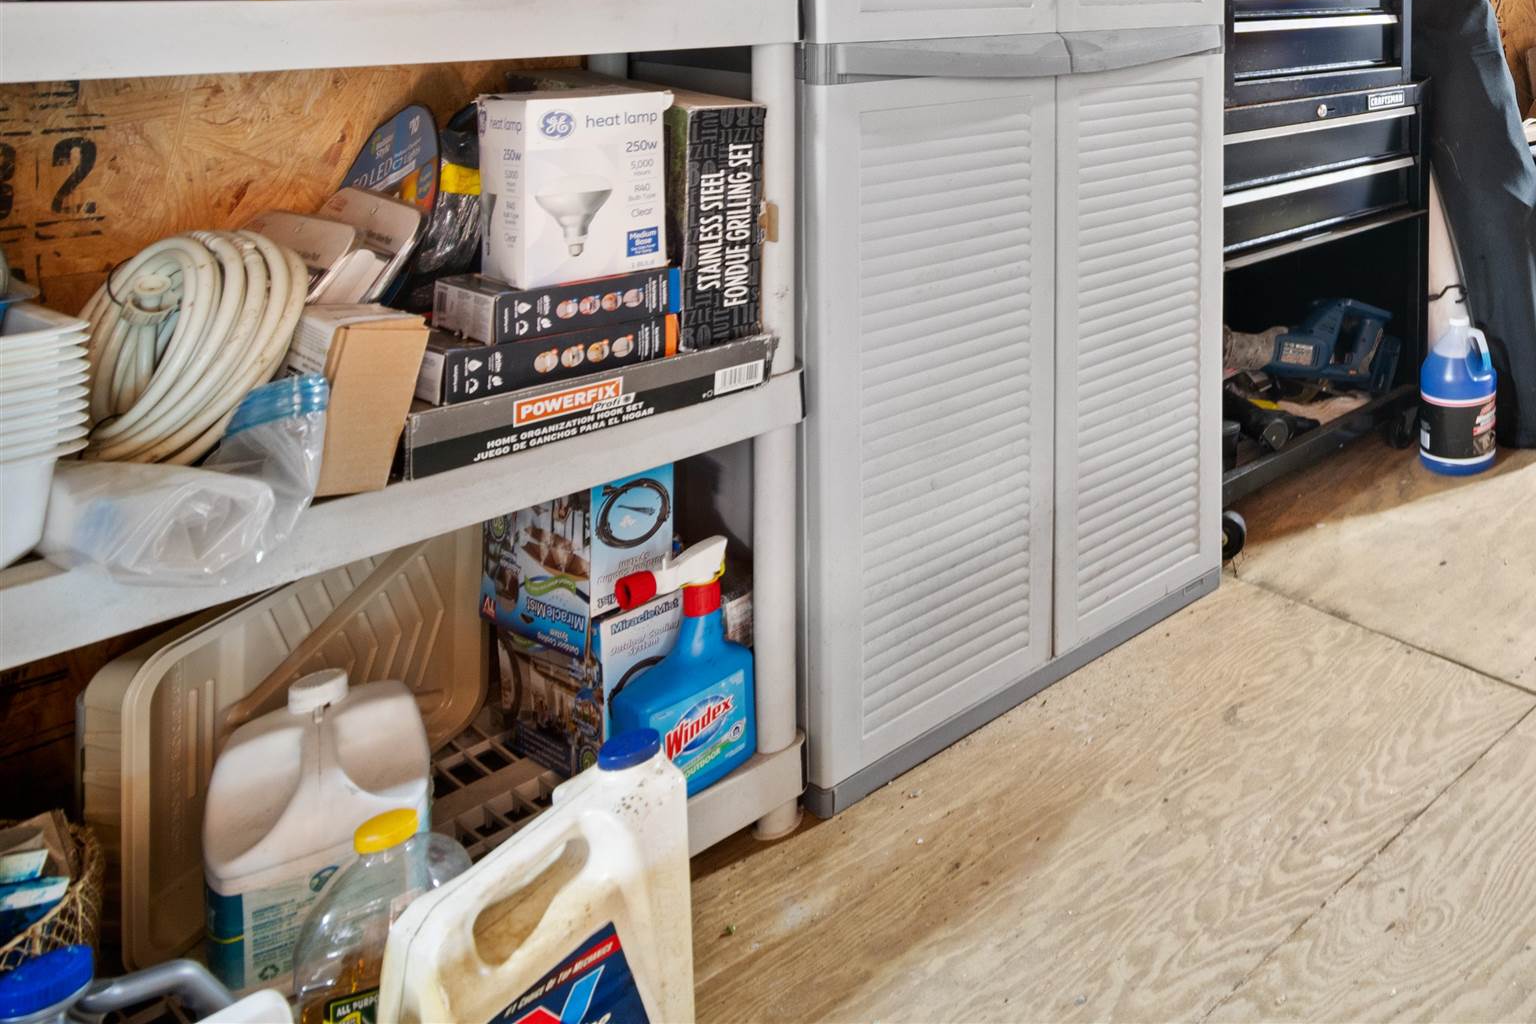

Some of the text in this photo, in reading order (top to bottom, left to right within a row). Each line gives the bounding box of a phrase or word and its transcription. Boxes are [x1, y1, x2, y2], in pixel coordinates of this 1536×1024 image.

[1369, 92, 1404, 108] CRAFTSMAN
[503, 118, 523, 135] lamp
[585, 110, 658, 129] heat lamp
[503, 147, 522, 163] 250w
[625, 139, 658, 154] 250w
[630, 158, 654, 171] 5,000
[633, 182, 651, 194] R40
[630, 206, 654, 219] Clear
[697, 169, 725, 291] STAINLESS STEEL
[724, 142, 753, 308] FONDUE GRILLING SET
[629, 228, 658, 242] Medium
[519, 380, 620, 420] POWERFIX
[593, 397, 622, 413] Profi
[486, 400, 645, 450] HOME ORGANIZATION HOOK SET
[473, 406, 656, 463] JUEGO DE GANCHOS PARA EL HOGAR
[526, 597, 586, 633] MiracleMist
[610, 598, 681, 635] MiracleMist
[549, 628, 570, 643] System
[609, 631, 646, 657] Outdoor
[557, 640, 580, 656] Outdoor
[627, 636, 661, 658] System
[664, 694, 734, 762] Windex
[336, 1003, 352, 1018] ALL
